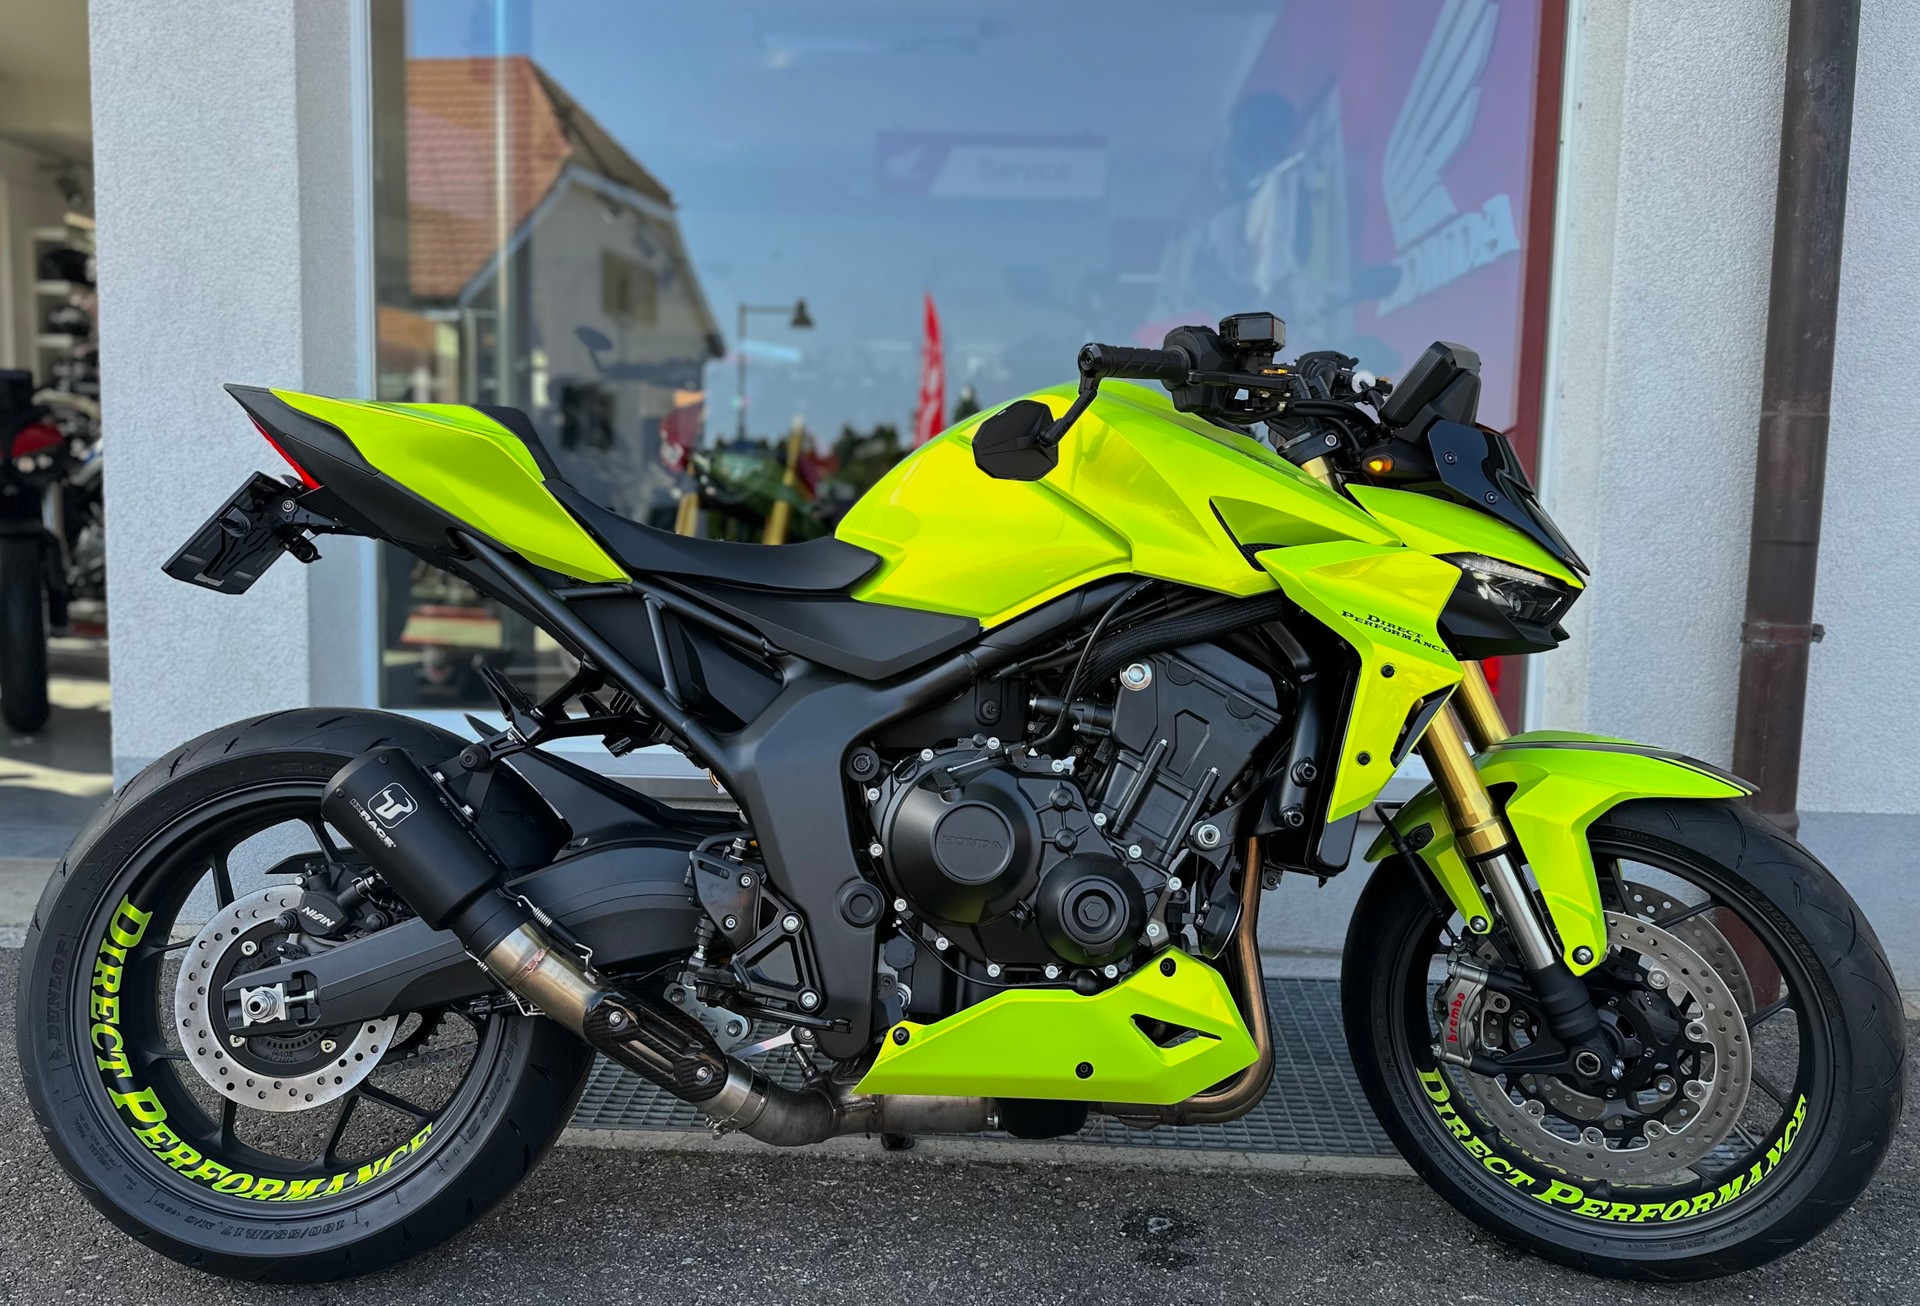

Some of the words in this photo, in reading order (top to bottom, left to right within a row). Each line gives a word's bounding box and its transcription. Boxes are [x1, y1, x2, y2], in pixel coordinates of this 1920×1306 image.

[977, 155, 1072, 182] Service
[1341, 609, 1450, 655] PERFORMANCE
[1367, 613, 1424, 638] DIRECT
[939, 834, 1004, 850] HONDA
[45, 939, 67, 1043] DUNLOP
[90, 894, 153, 1078] DIRECT
[1445, 992, 1466, 1044] brembo
[108, 1085, 432, 1202] PERFORMANCE
[1416, 1067, 1535, 1187] DIRECT
[1534, 1093, 1808, 1223] PERFORMANCE
